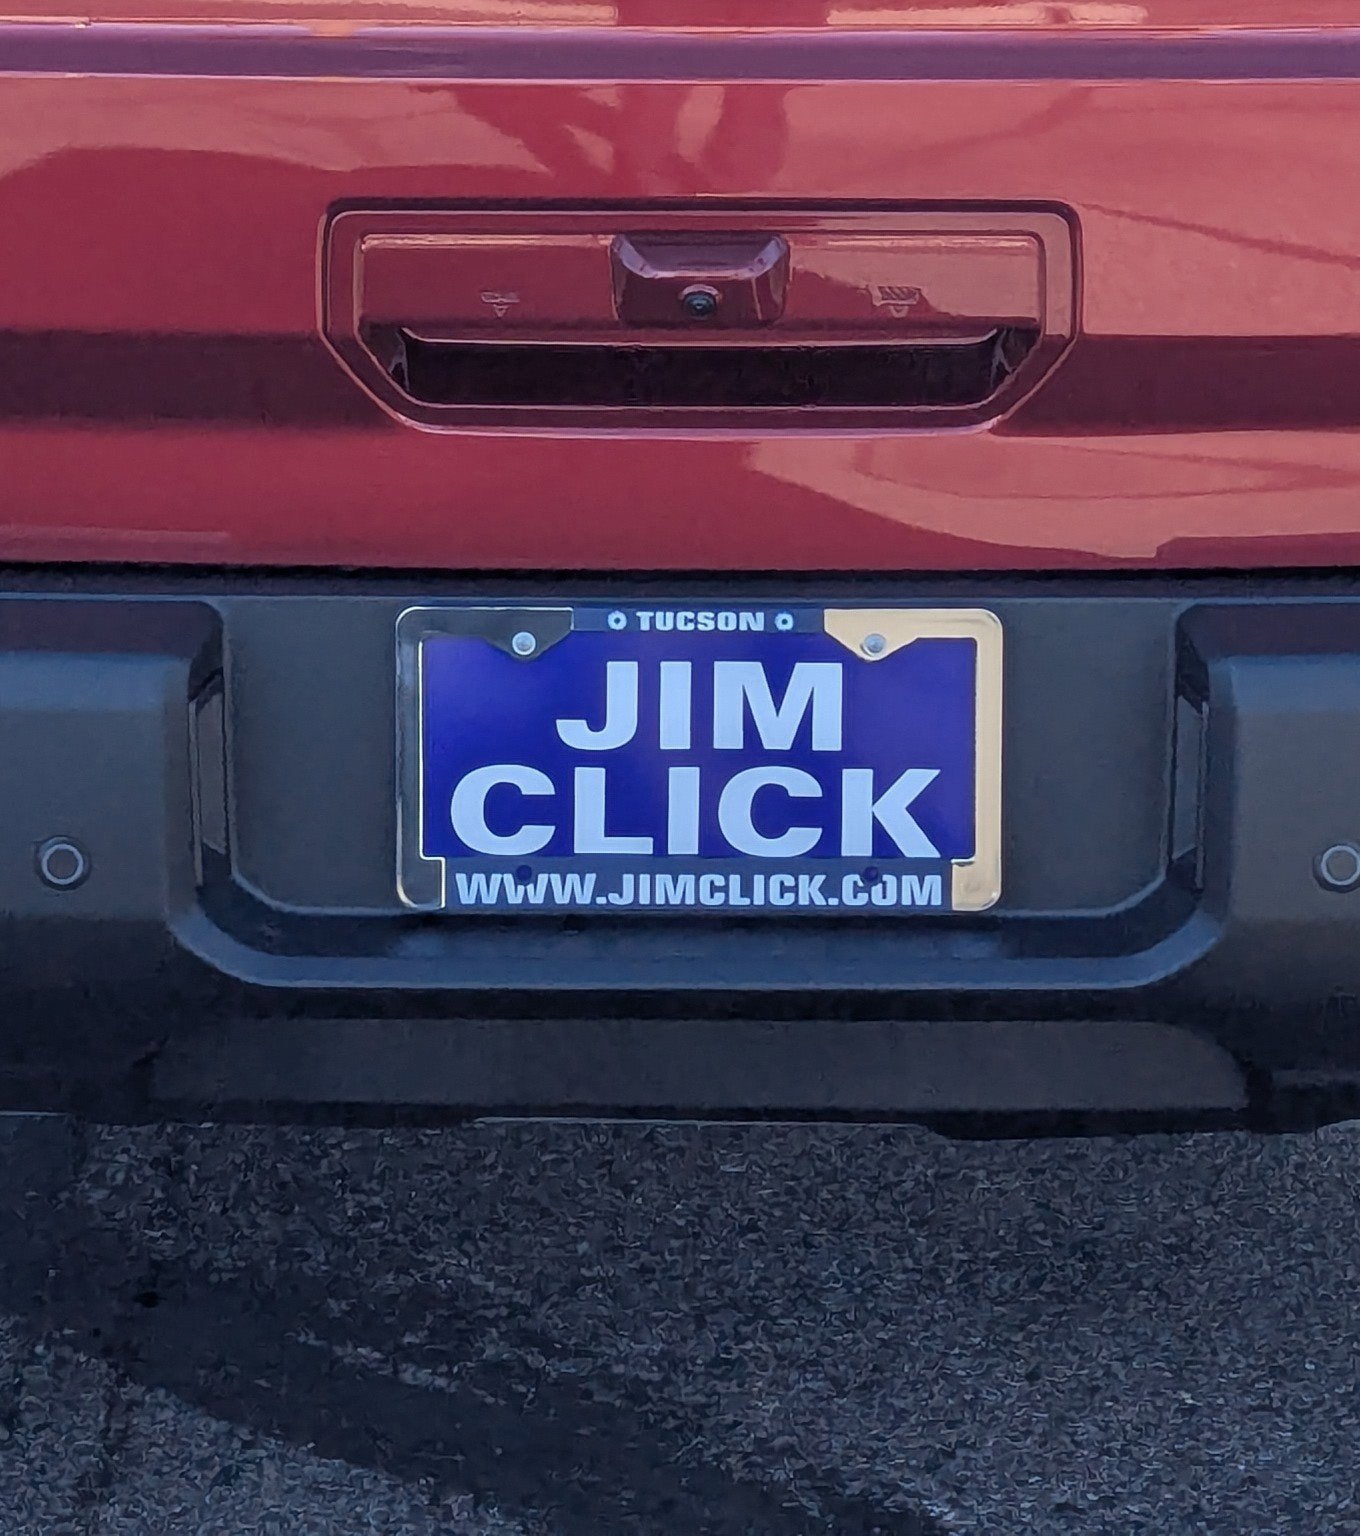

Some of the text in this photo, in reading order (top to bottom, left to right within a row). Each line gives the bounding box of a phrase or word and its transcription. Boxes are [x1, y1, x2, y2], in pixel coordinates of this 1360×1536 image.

[636, 611, 765, 632] TUCSON
[555, 661, 843, 752] JIM
[450, 764, 942, 858] CLICK
[454, 872, 943, 907] WWW.JIMCLICK.COM
